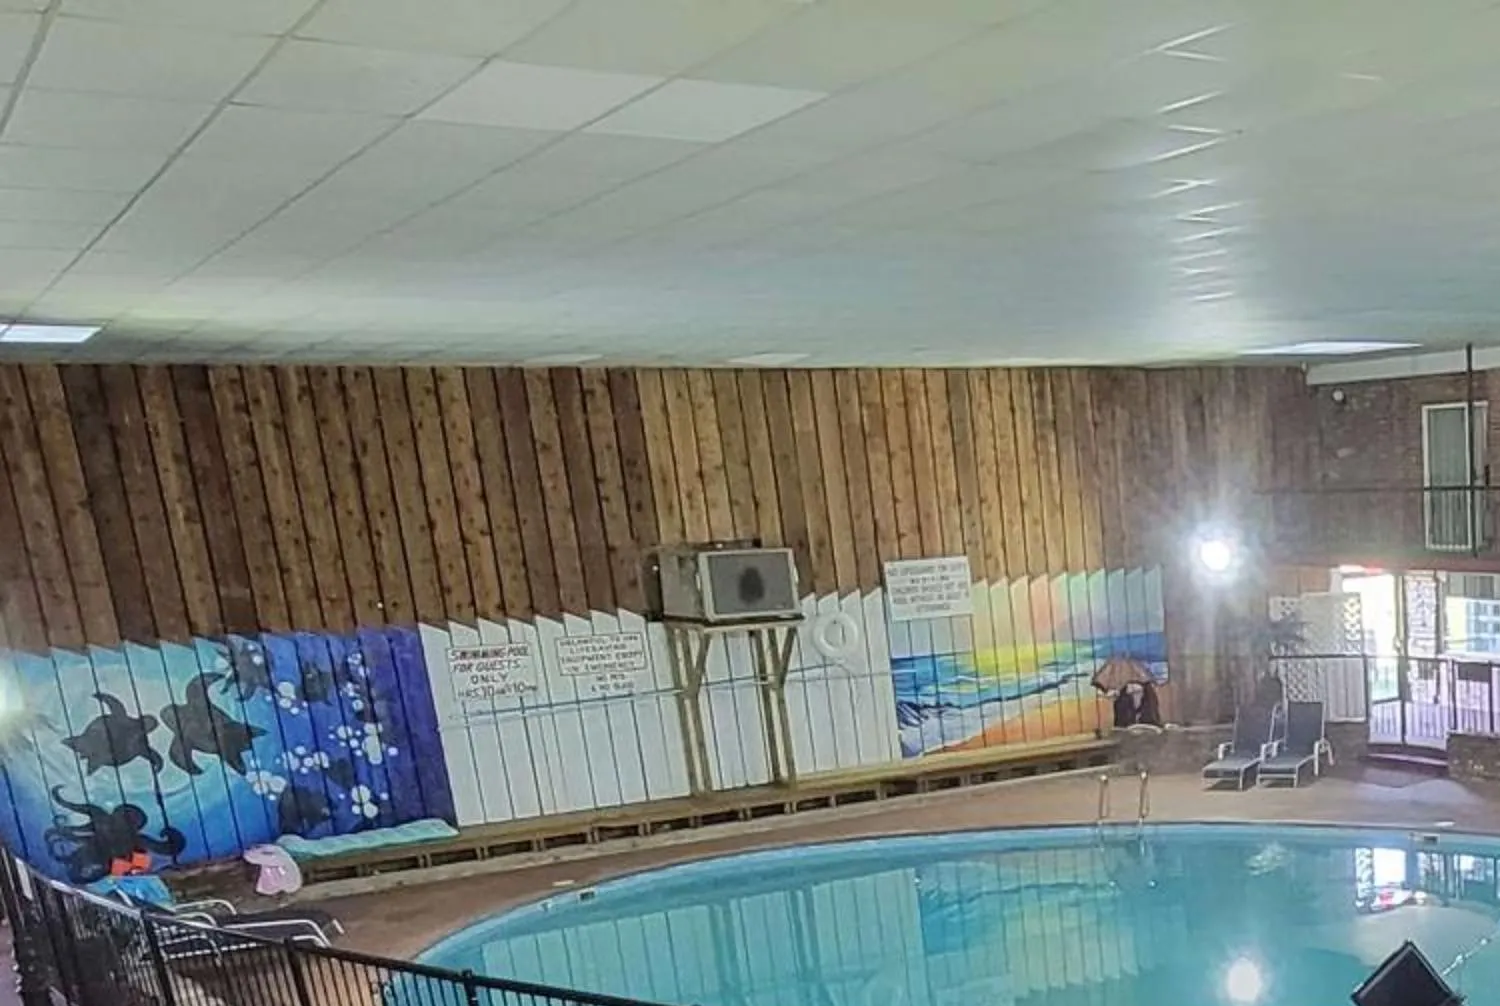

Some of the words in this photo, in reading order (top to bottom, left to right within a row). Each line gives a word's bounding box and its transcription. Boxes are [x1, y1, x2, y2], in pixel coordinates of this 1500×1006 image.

[450, 647, 506, 661] SWIMMING
[506, 644, 530, 657] POOL
[453, 663, 475, 674] FOR
[476, 659, 522, 673] GUESTS
[469, 673, 509, 685] ONLY
